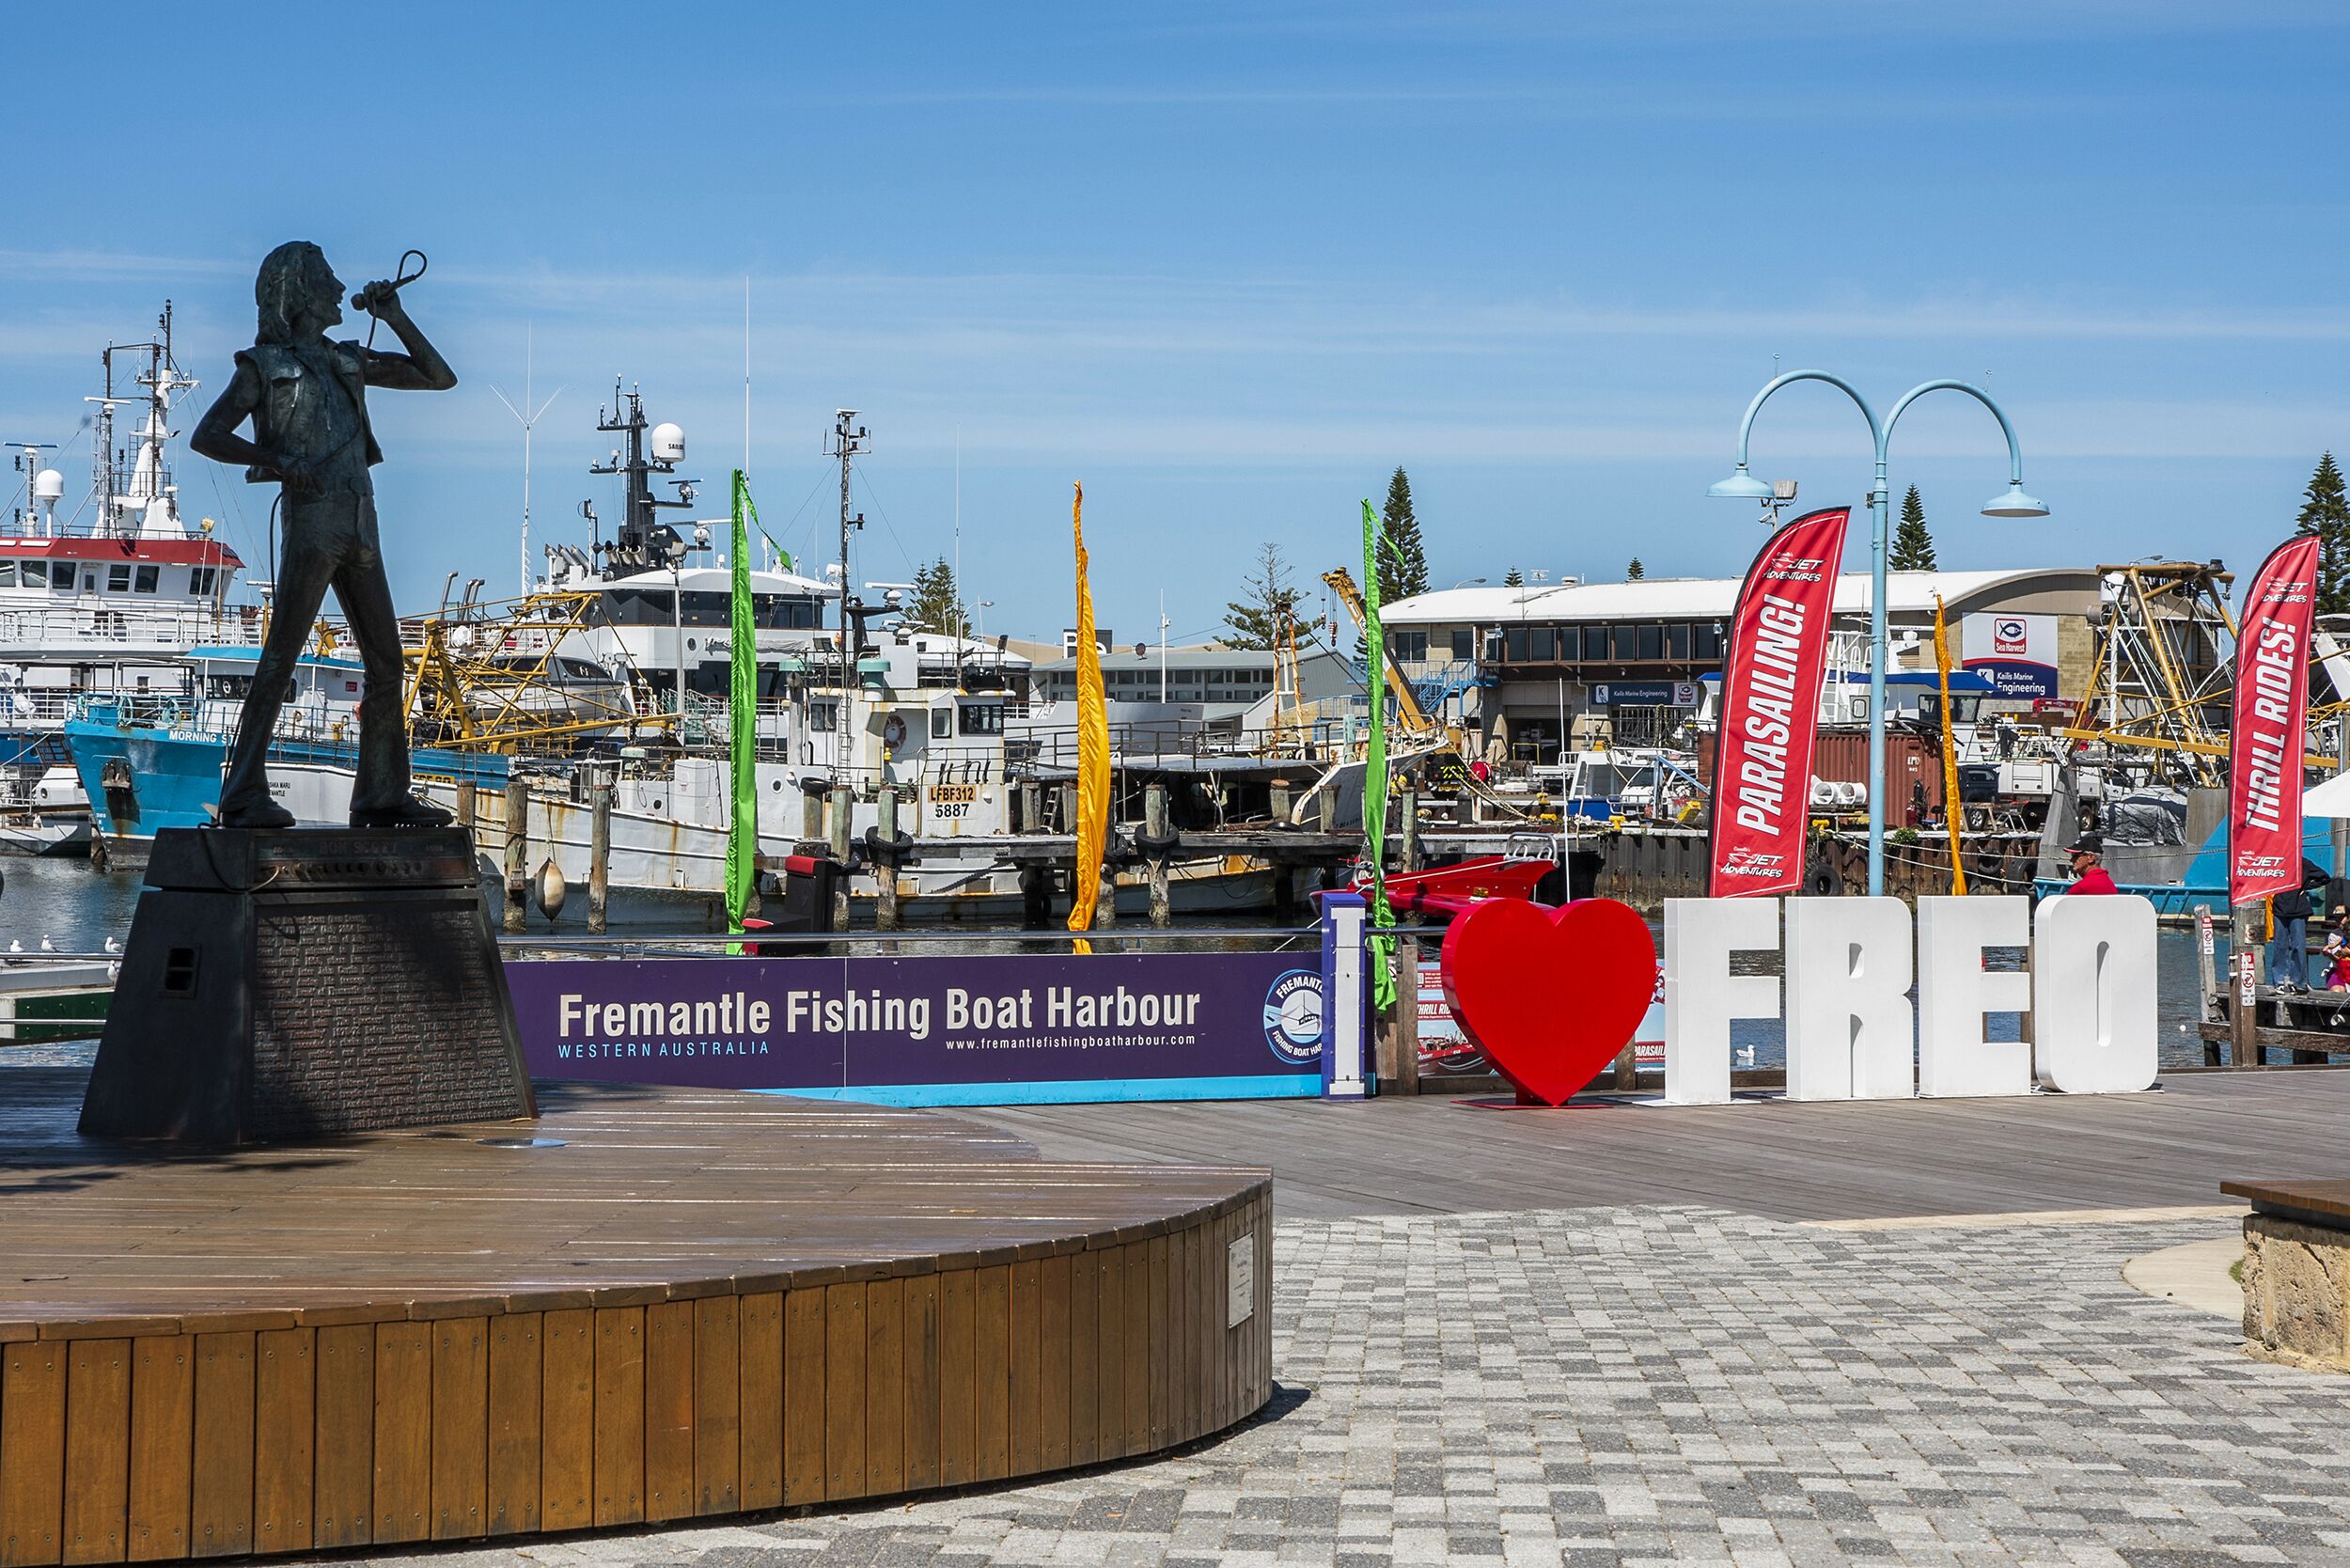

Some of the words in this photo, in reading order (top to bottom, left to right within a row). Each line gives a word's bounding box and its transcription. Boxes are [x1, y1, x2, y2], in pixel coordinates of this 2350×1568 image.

[1788, 558, 1825, 570] JET
[1996, 642, 2006, 652] Sea
[2006, 642, 2025, 653] Harvest
[2013, 672, 2034, 681] Marine
[2254, 616, 2296, 726] RIDES!
[1639, 689, 1668, 698] Engineering
[1998, 682, 2045, 696] Engineering
[1736, 593, 1806, 837] PARASAILING!
[169, 730, 217, 744] MORNING
[2245, 731, 2286, 833] THRILL
[931, 786, 974, 802] LFBF312
[935, 803, 970, 819] 5887
[1745, 854, 1784, 867] JET
[2251, 855, 2285, 867] JET
[1719, 861, 1784, 879] ADVENTURES
[2235, 865, 2286, 878] ADVENTURES
[1276, 976, 1322, 998] FREMANT
[1666, 894, 2158, 1105] FREO
[559, 992, 770, 1038] Fremantle
[788, 989, 930, 1041] Fishing
[947, 988, 1032, 1029] Boat
[1047, 985, 1200, 1027] Harbour
[1439, 1003, 1450, 1015] RID
[557, 1043, 651, 1058] WESTERN
[659, 1041, 769, 1058] AUSTRALIA
[946, 1034, 1196, 1050] www.fremantlefishingboatharbour.com
[1272, 1030, 1293, 1054] FISHING
[1293, 1046, 1310, 1058] BOAT
[1310, 1043, 1322, 1055] HAR
